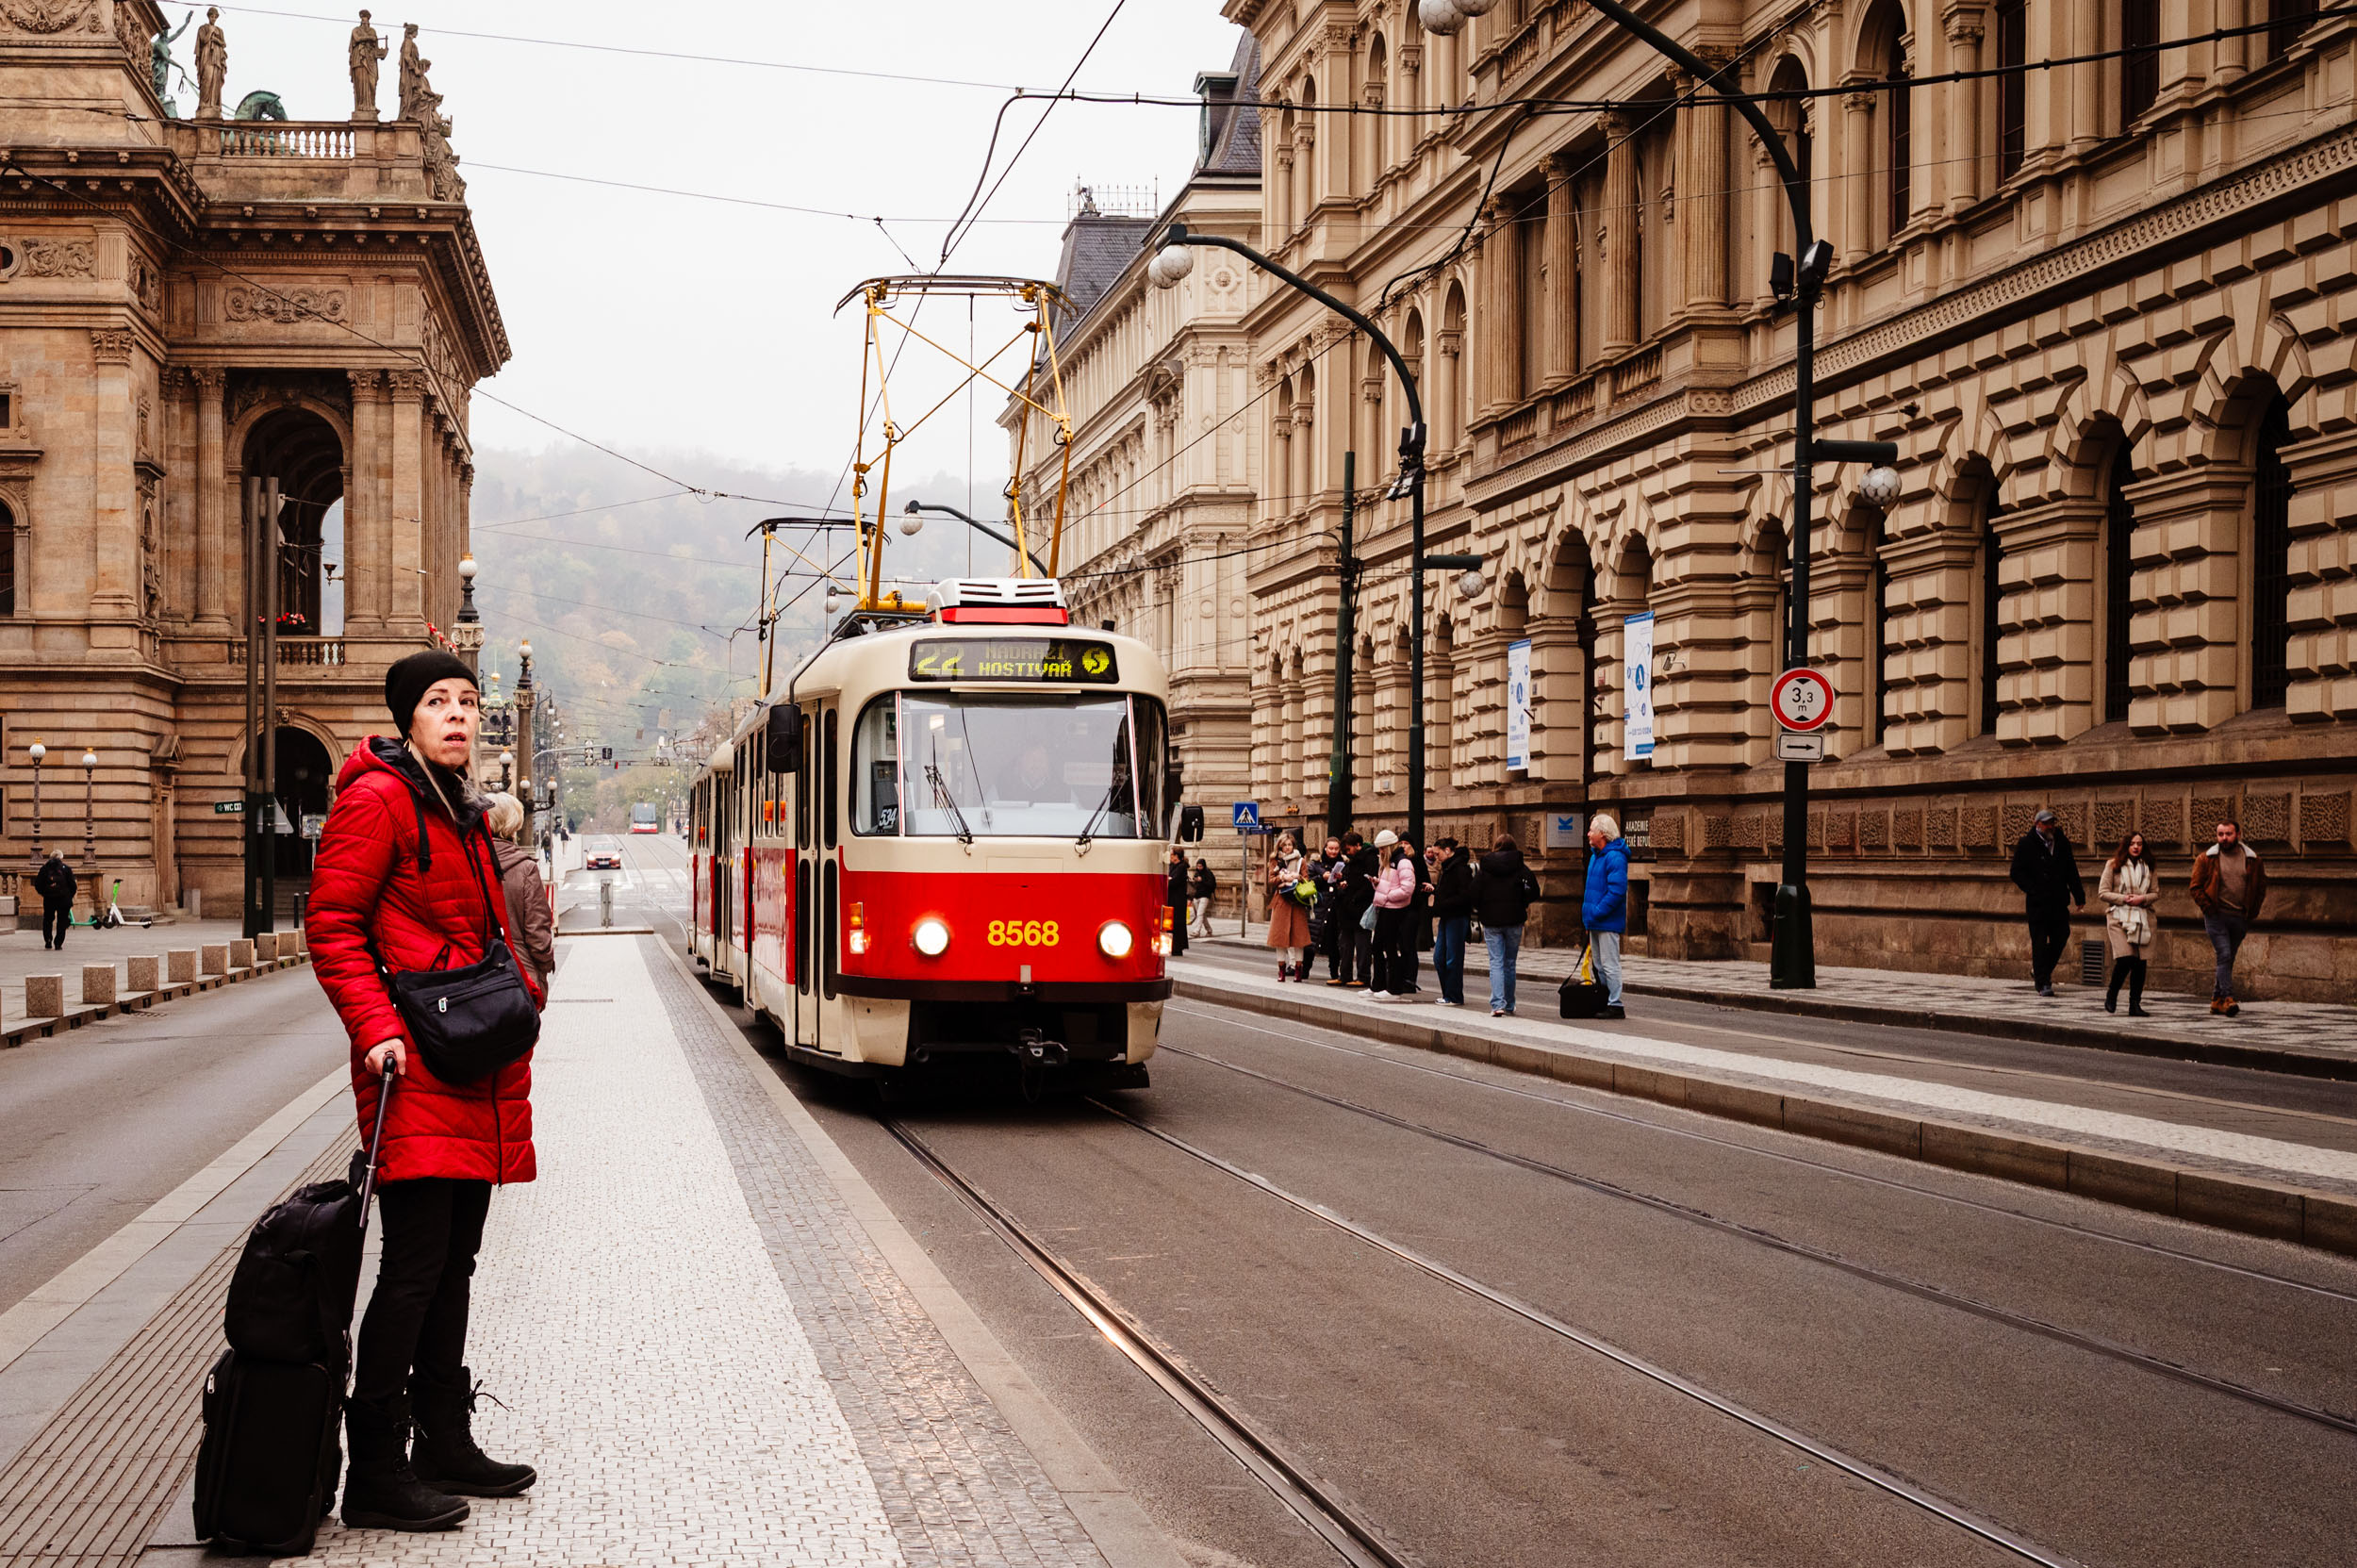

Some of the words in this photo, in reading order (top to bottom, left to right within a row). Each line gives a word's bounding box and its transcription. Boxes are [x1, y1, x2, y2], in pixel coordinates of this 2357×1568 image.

[917, 645, 964, 675] 22
[979, 660, 1072, 677] HOSTIVAŘ
[1792, 687, 1814, 703] 3,3
[223, 803, 234, 812] WC
[879, 808, 898, 826] 534
[1624, 820, 1649, 832] AKADEMIE
[987, 919, 1060, 947] 8568
